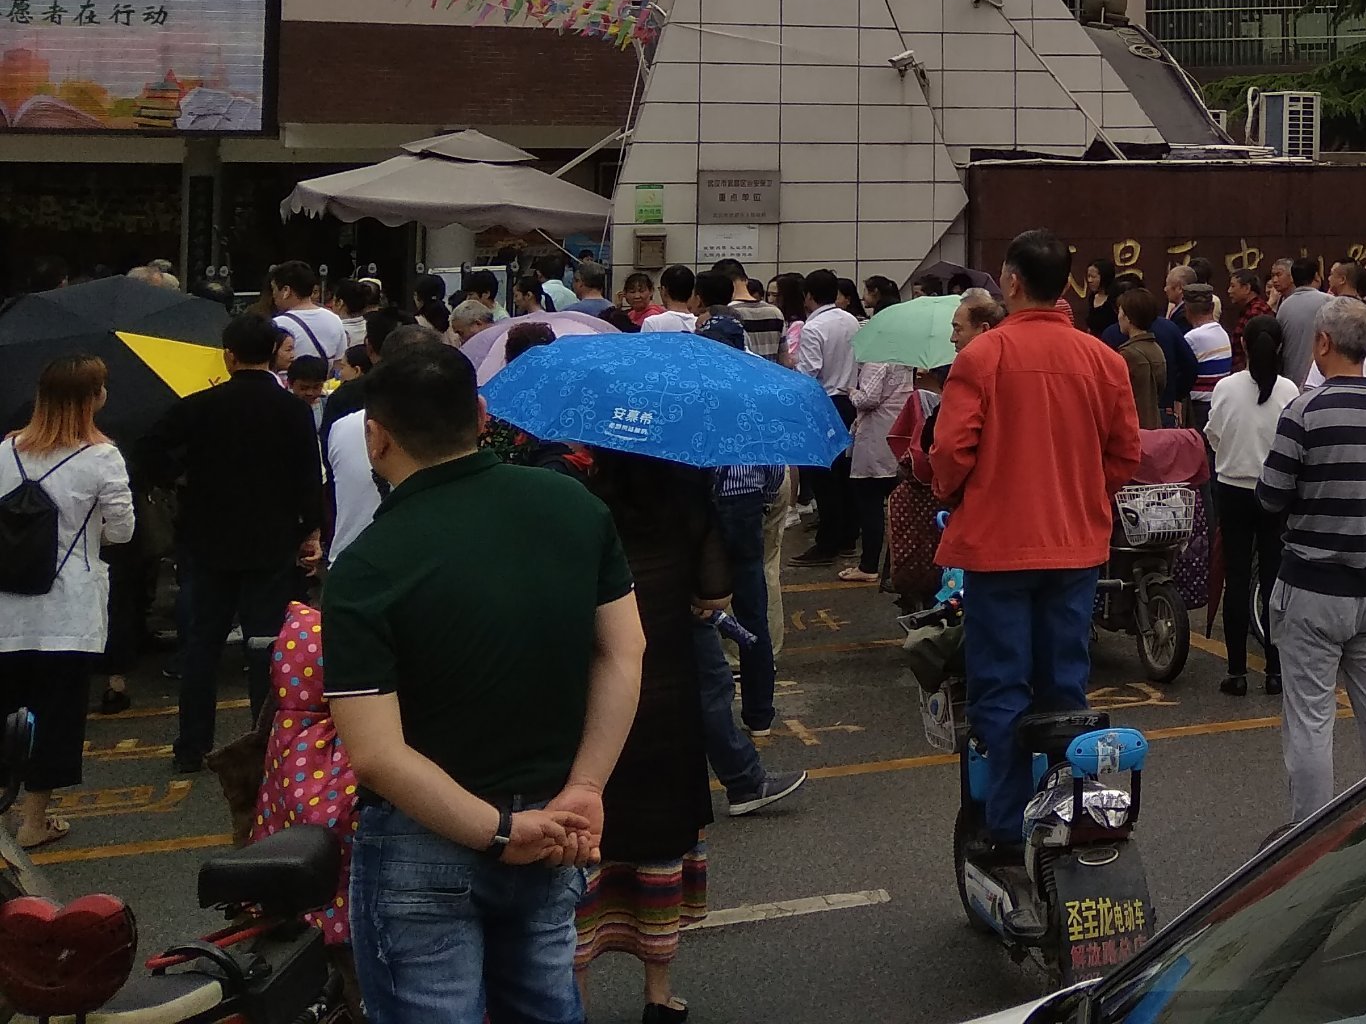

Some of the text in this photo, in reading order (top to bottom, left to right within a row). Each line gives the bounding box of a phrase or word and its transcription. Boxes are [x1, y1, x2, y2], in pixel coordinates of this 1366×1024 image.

[1065, 897, 1146, 942] 圣宝龙电动车
